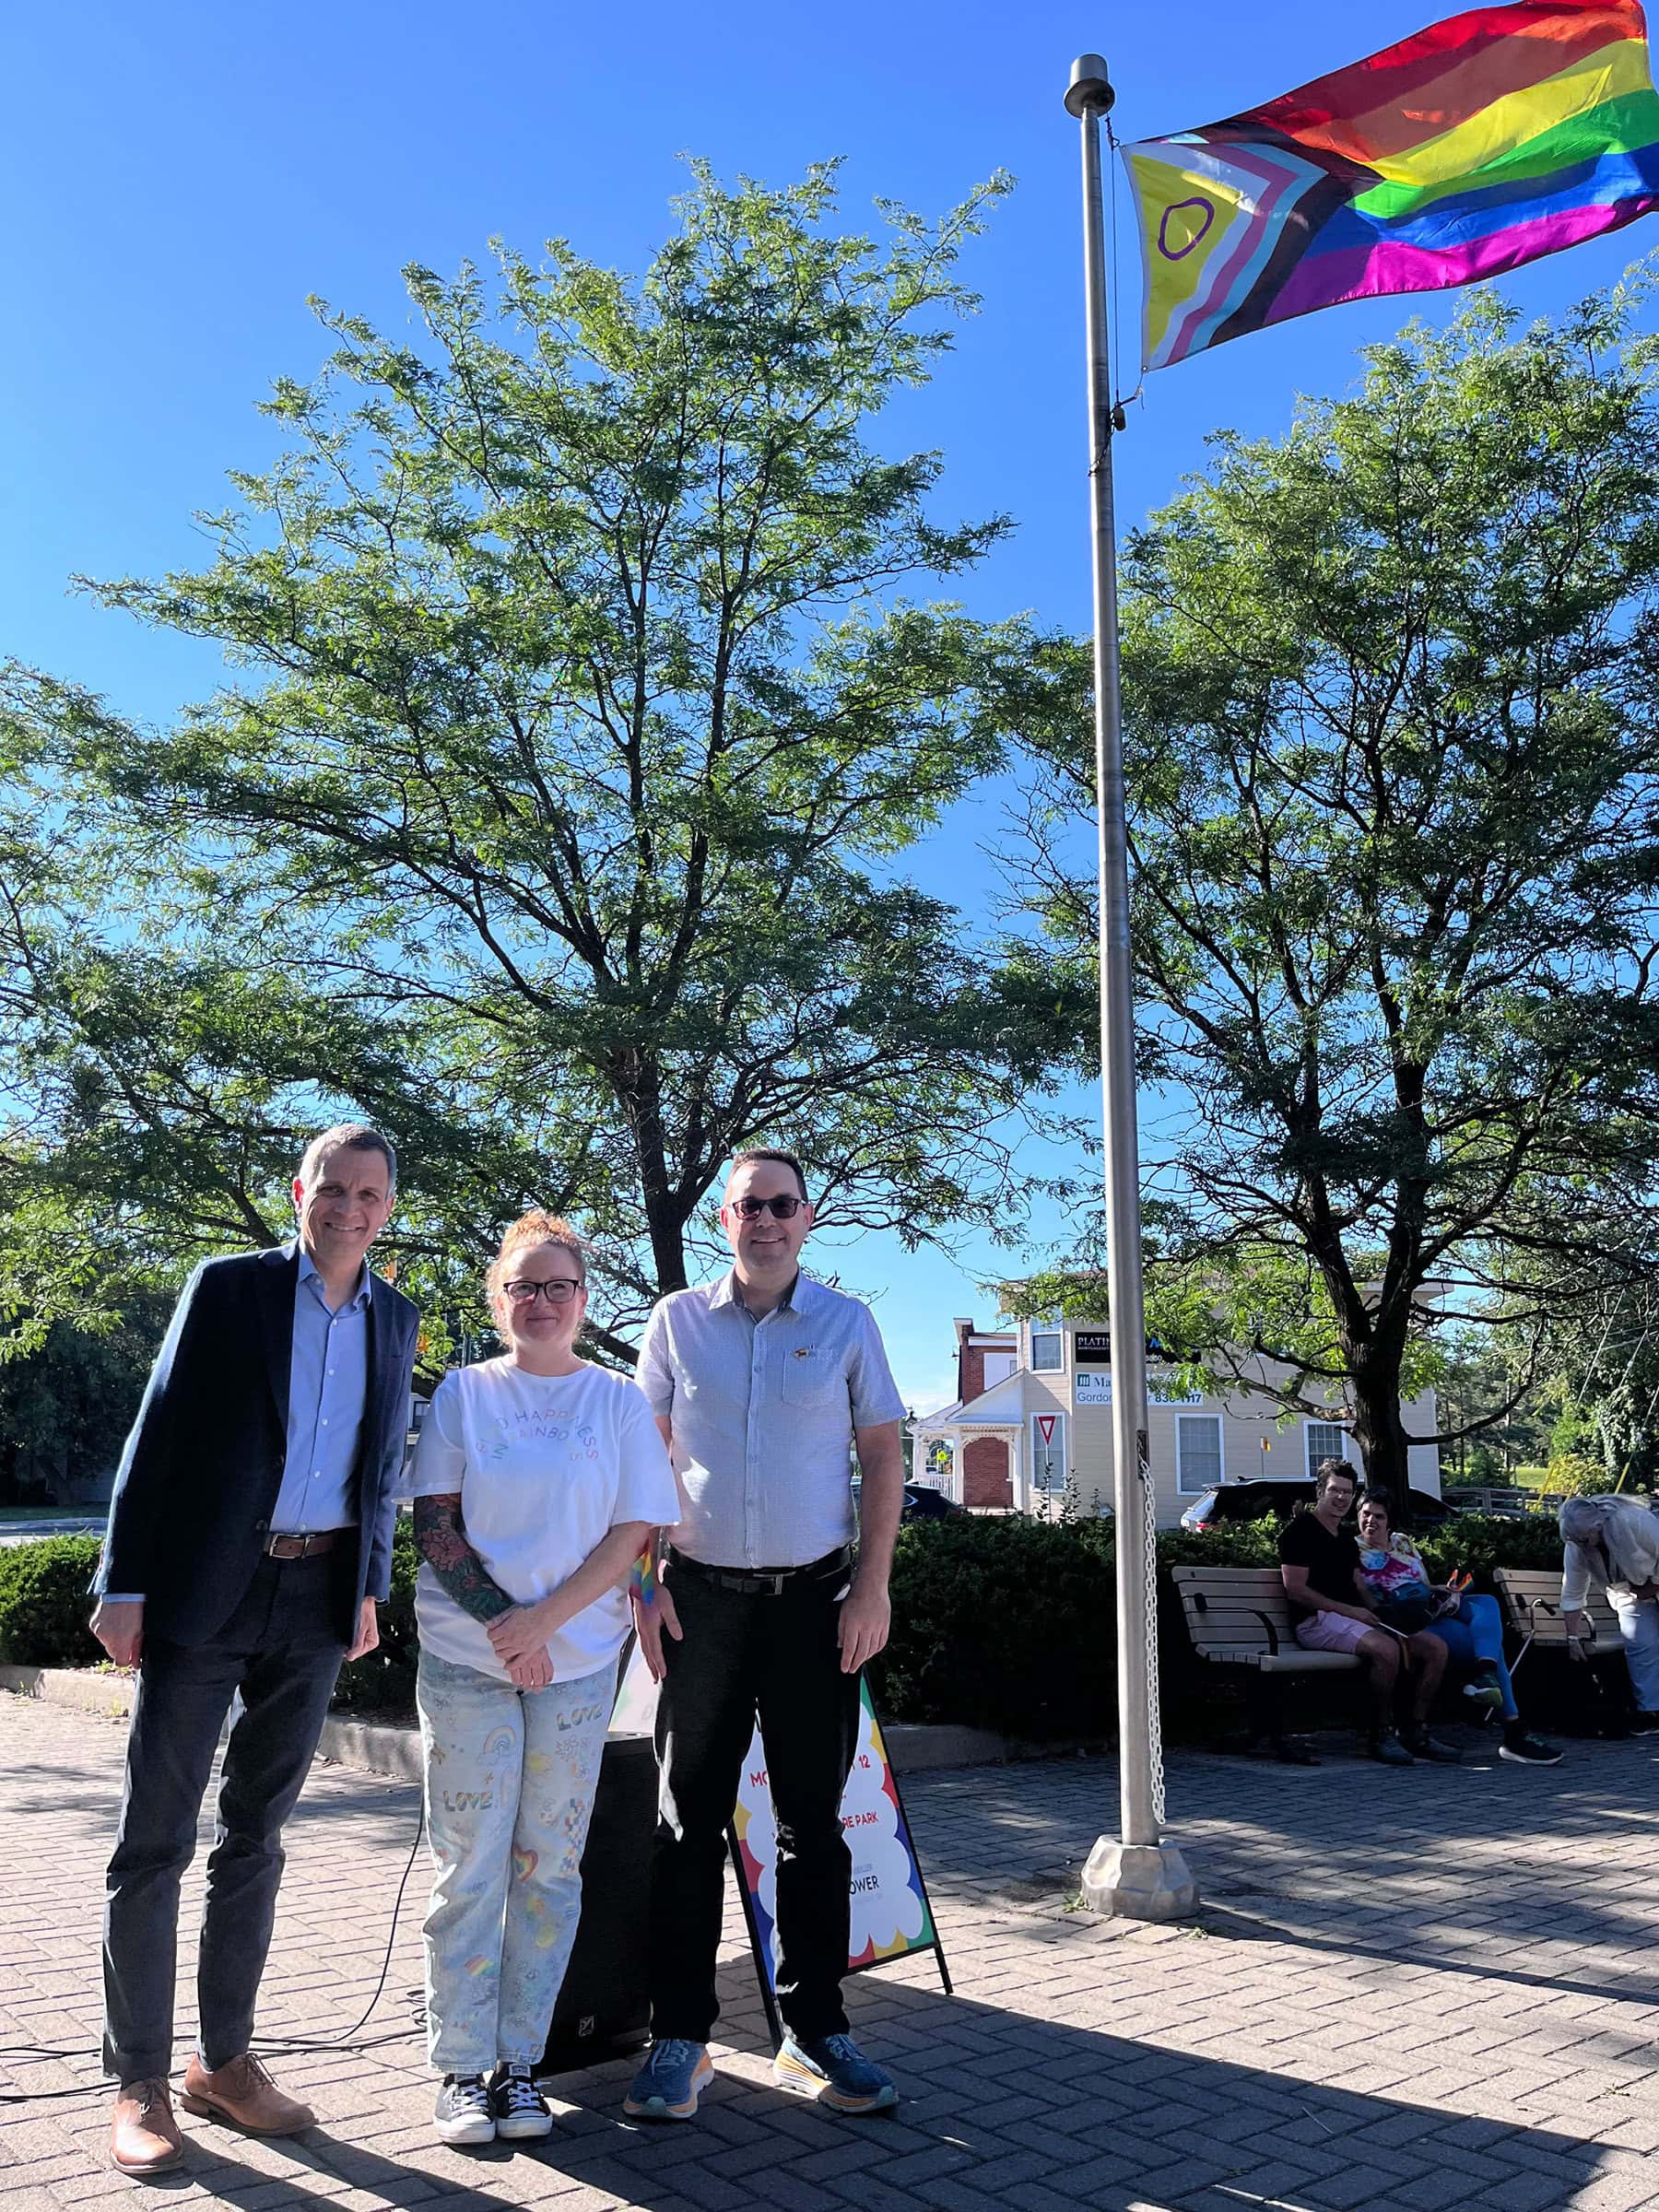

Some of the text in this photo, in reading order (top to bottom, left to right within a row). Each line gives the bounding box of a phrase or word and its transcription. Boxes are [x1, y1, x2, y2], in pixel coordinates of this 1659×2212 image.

[1094, 1376, 1112, 1387] Ma
[557, 1704, 603, 1731] LOVE
[749, 1770, 768, 1787] MO
[858, 1755, 871, 1769] 12
[442, 1790, 493, 1812] LOVE
[841, 1811, 879, 1829] RE PARK
[849, 1875, 879, 1895] OWER
